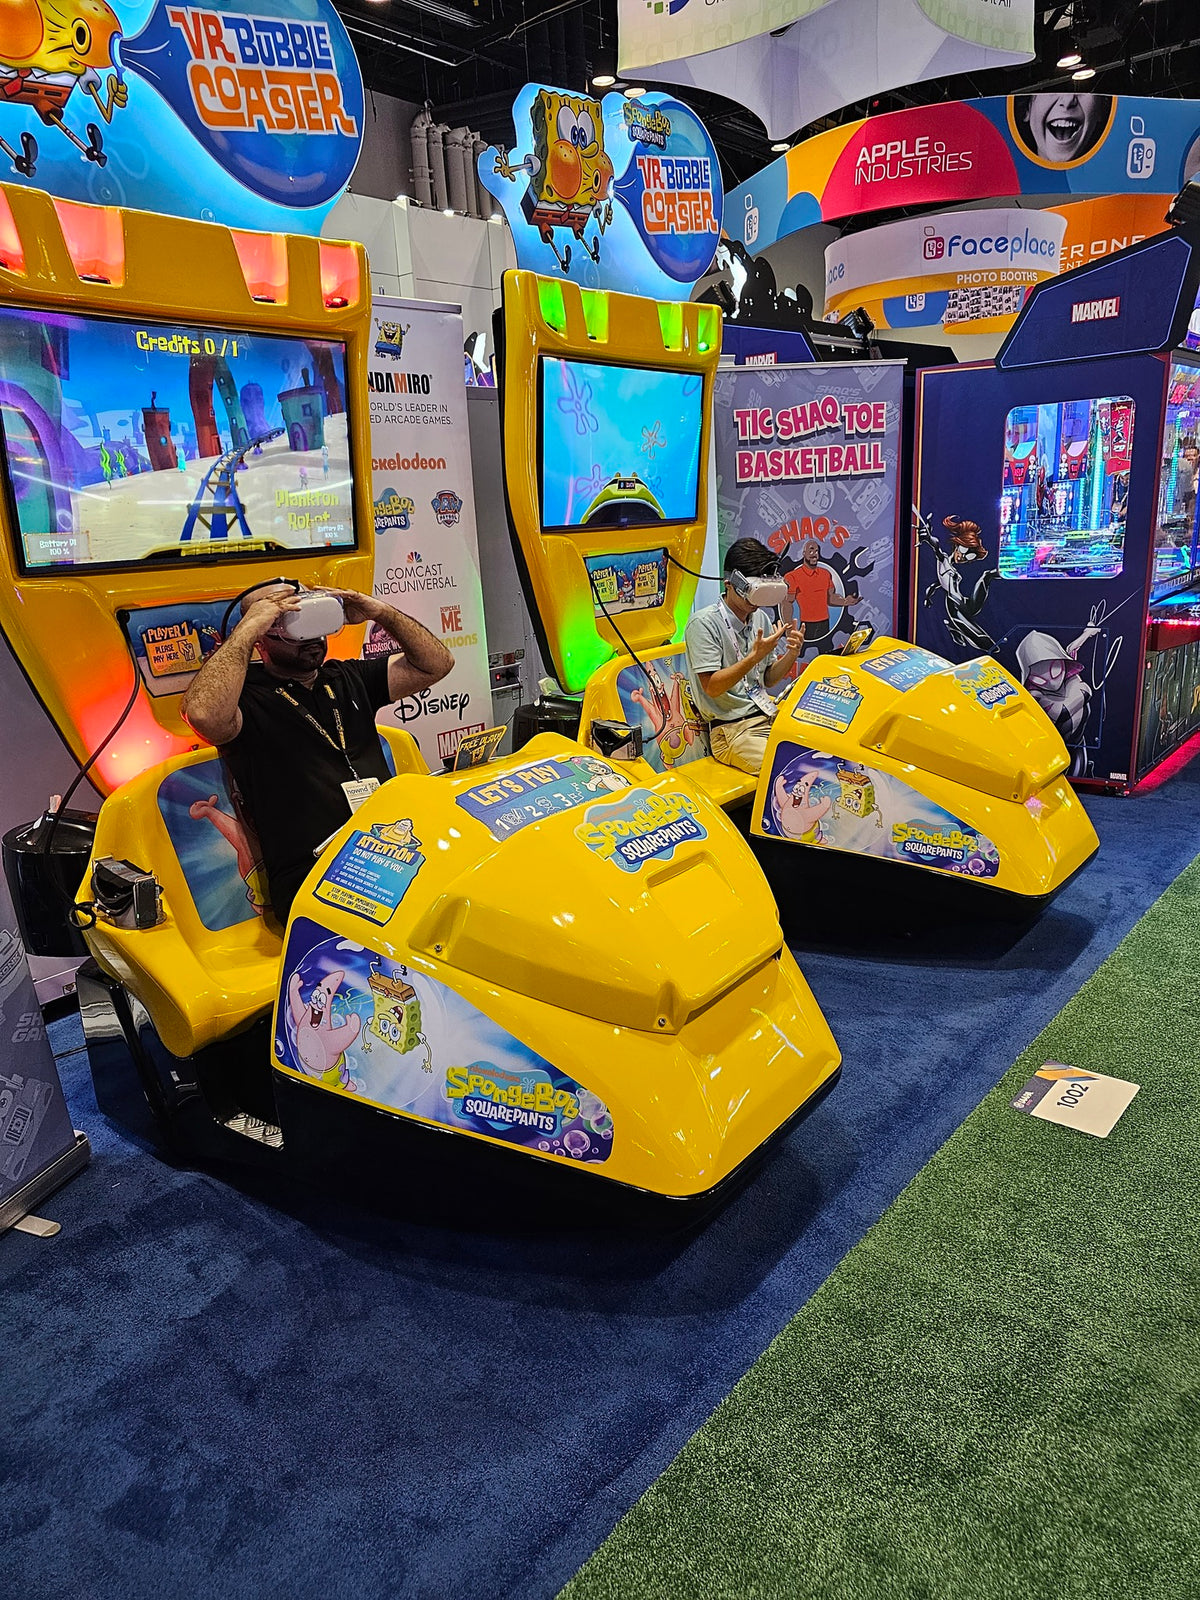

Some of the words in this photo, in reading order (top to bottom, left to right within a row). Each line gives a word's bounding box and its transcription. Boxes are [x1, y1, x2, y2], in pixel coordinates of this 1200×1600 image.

[169, 10, 236, 64] VR
[224, 17, 334, 70] BUBBLE
[190, 64, 357, 135] COASTER
[856, 136, 930, 167] APPLE
[637, 157, 664, 191] VR
[661, 157, 710, 190] BUBBLE
[855, 151, 973, 186] INDUSTRIES
[642, 192, 717, 234] COASTER
[956, 271, 998, 285] PHOTO
[1000, 270, 1038, 282] BOOTHS
[1071, 297, 1120, 323] MARVEL
[136, 331, 201, 354] Credits
[745, 352, 777, 366] MARVEL
[385, 414, 421, 424] ARCADE
[422, 415, 453, 425] GAMES.
[405, 403, 437, 413] LEADER
[439, 404, 448, 413] IN
[734, 408, 774, 440] TIC
[776, 395, 840, 440] SHAQ
[842, 402, 887, 434] TOE
[736, 442, 886, 483] BASKETBALL
[275, 489, 340, 508] Plankton
[39, 539, 69, 549] Battery
[49, 548, 62, 556] 100
[386, 563, 443, 581] COMCAST
[374, 576, 458, 596] NBCUNIVERSAL
[147, 625, 182, 643] PLAYER
[181, 621, 190, 636] 1
[440, 611, 463, 634] ME
[153, 655, 164, 664] PAY
[166, 652, 180, 661] HERE
[155, 644, 175, 654] PLEASE
[814, 683, 856, 700] ATTENTION
[468, 779, 525, 807] LET'S
[516, 764, 561, 789] PLAY
[524, 805, 544, 818] 2
[552, 793, 573, 807] 3
[356, 835, 415, 864] ATTENTION
[620, 819, 698, 861] SQUAREPANTS
[905, 841, 963, 860] SQUAREPANTS
[361, 850, 371, 860] NOT
[371, 853, 385, 866] PLAY
[1056, 1083, 1090, 1109] 1002
[465, 1098, 555, 1131] SQUAREPANTS
